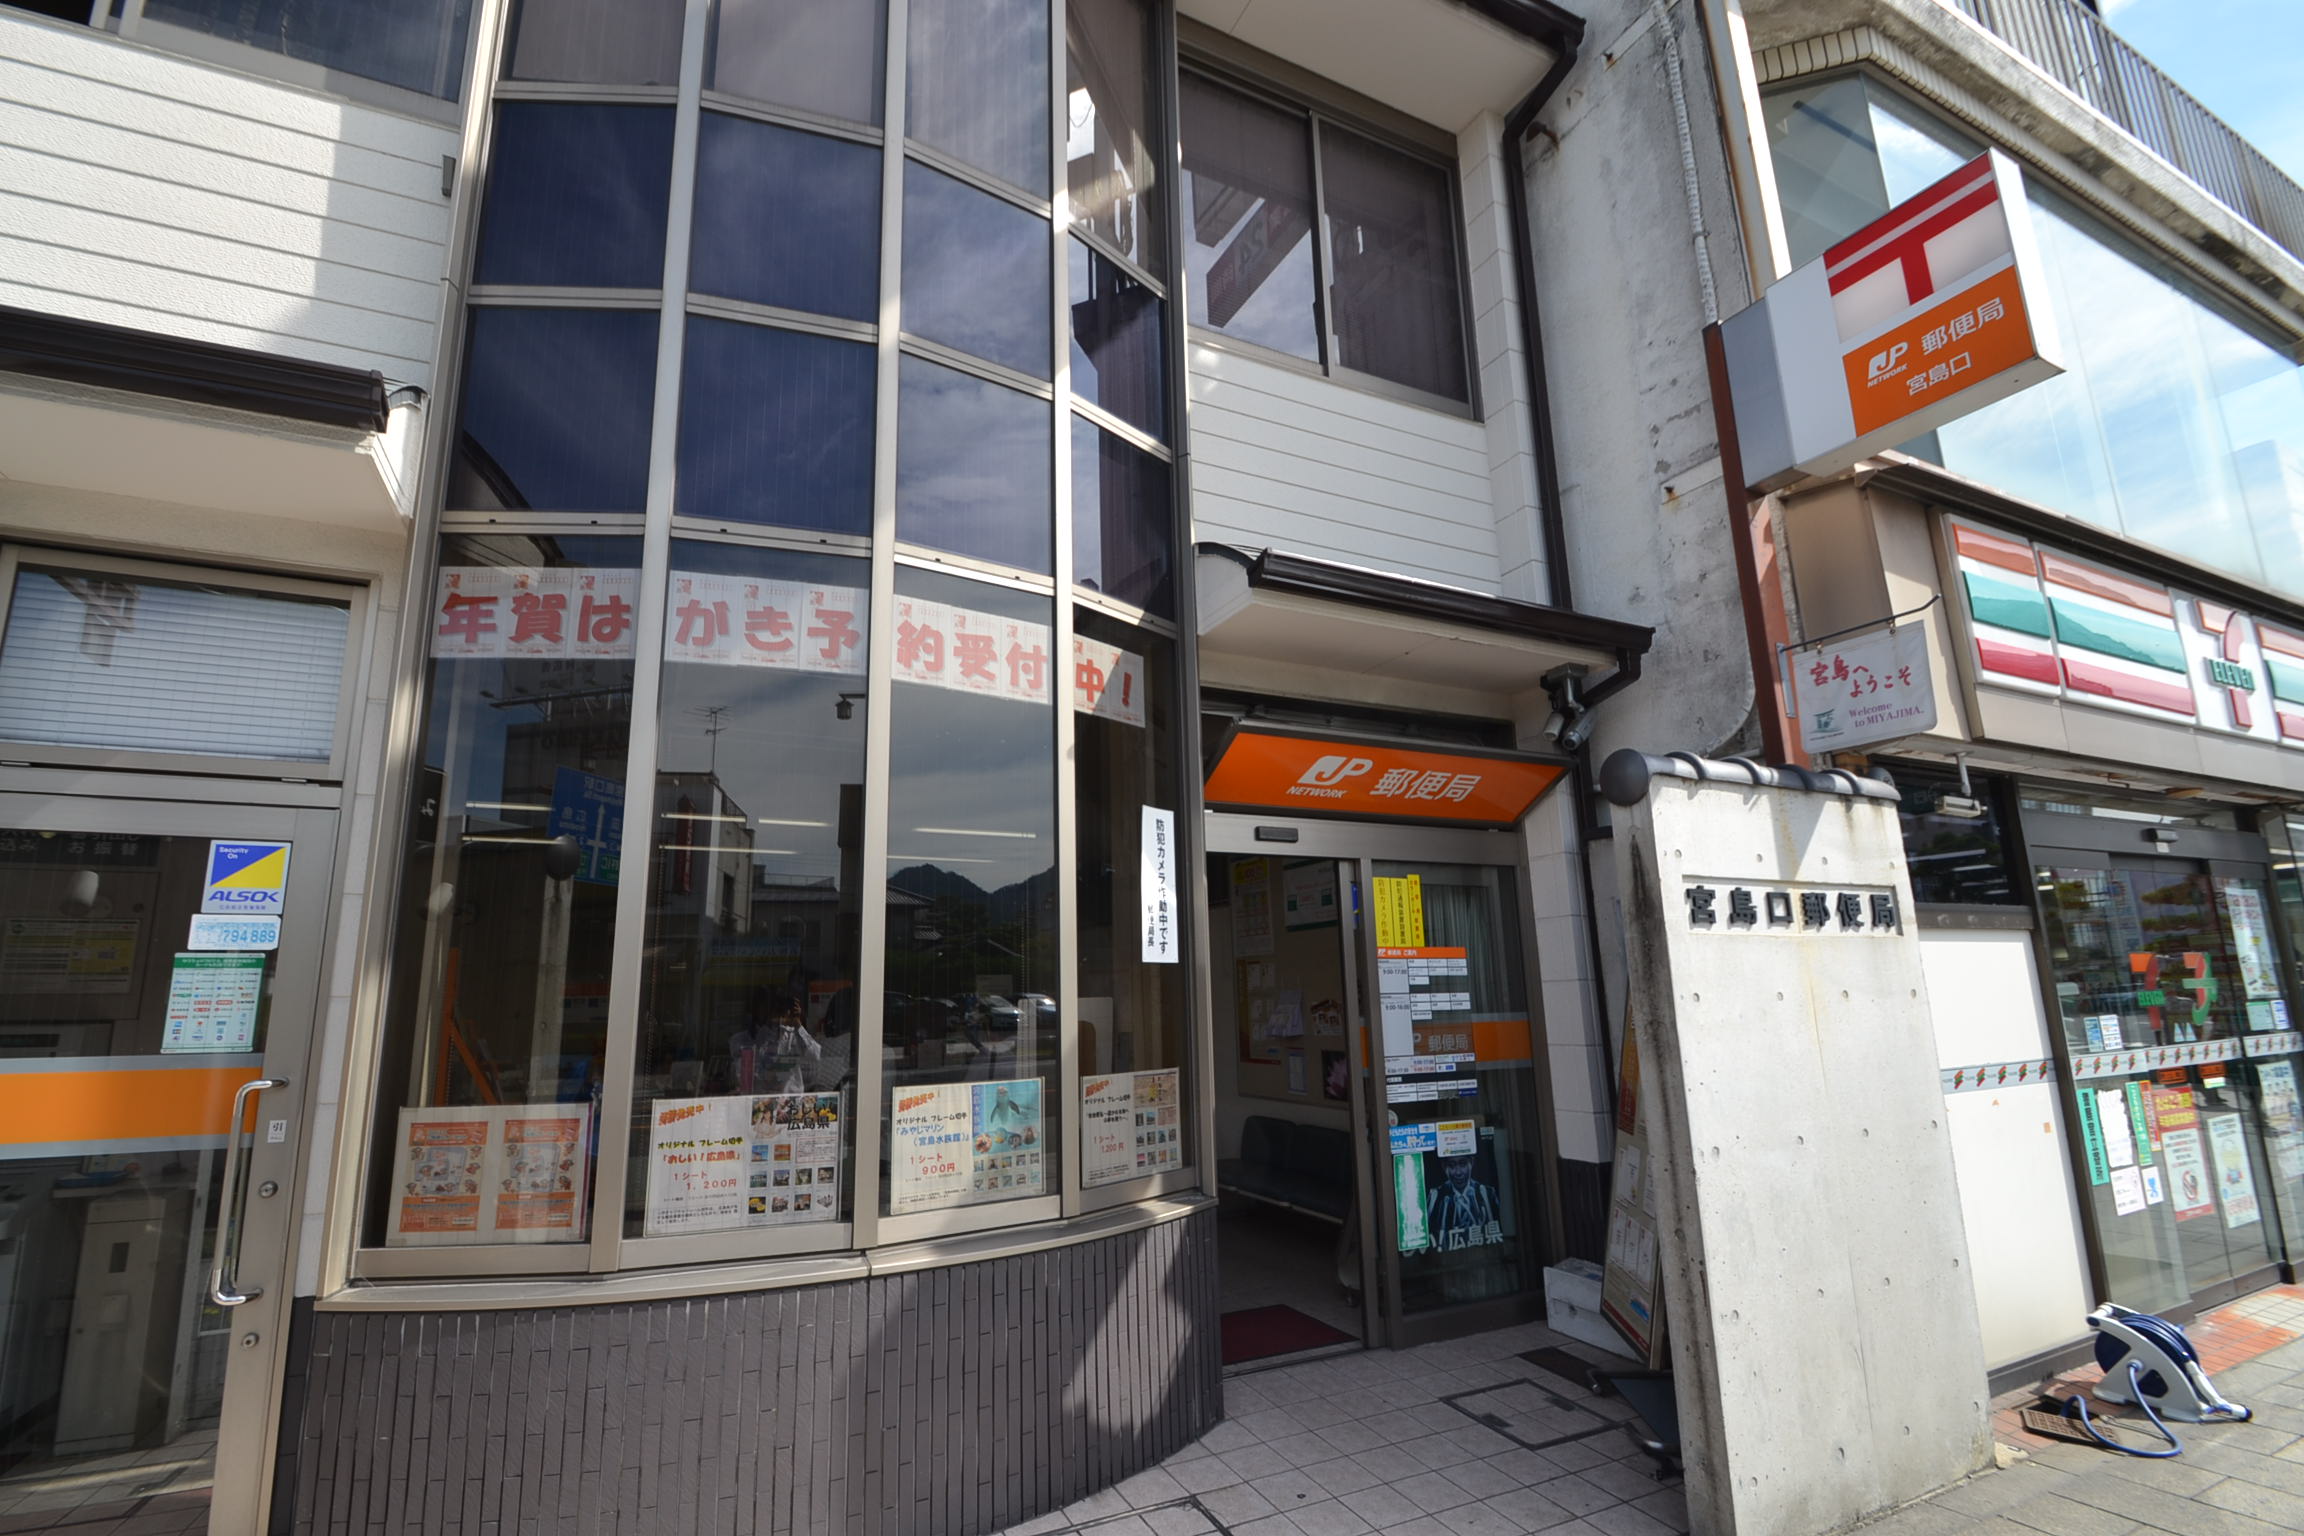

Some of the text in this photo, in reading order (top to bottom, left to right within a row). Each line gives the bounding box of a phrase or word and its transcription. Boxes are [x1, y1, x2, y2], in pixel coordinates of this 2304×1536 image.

[1921, 297, 2005, 355] 郵便局
[1867, 363, 1908, 388] NETWORK
[1906, 352, 1972, 396] 宮島口
[1809, 654, 1869, 687] 宮島へ
[1850, 665, 1912, 698] ようこそ
[1848, 702, 1893, 718] Welcome
[1854, 719, 1865, 728] to
[1286, 786, 1348, 799] NETWORK
[1369, 767, 1481, 802] 郵便局
[219, 846, 249, 854] Security
[208, 890, 280, 903] ALSOK
[1685, 885, 1895, 927] 宮島口郵便局
[1428, 1034, 1468, 1051] 郵便局
[787, 1112, 831, 1131] 広島県
[896, 1116, 927, 1126] オリジナル
[658, 1140, 695, 1150] オリジナル
[922, 1162, 955, 1175] 900円
